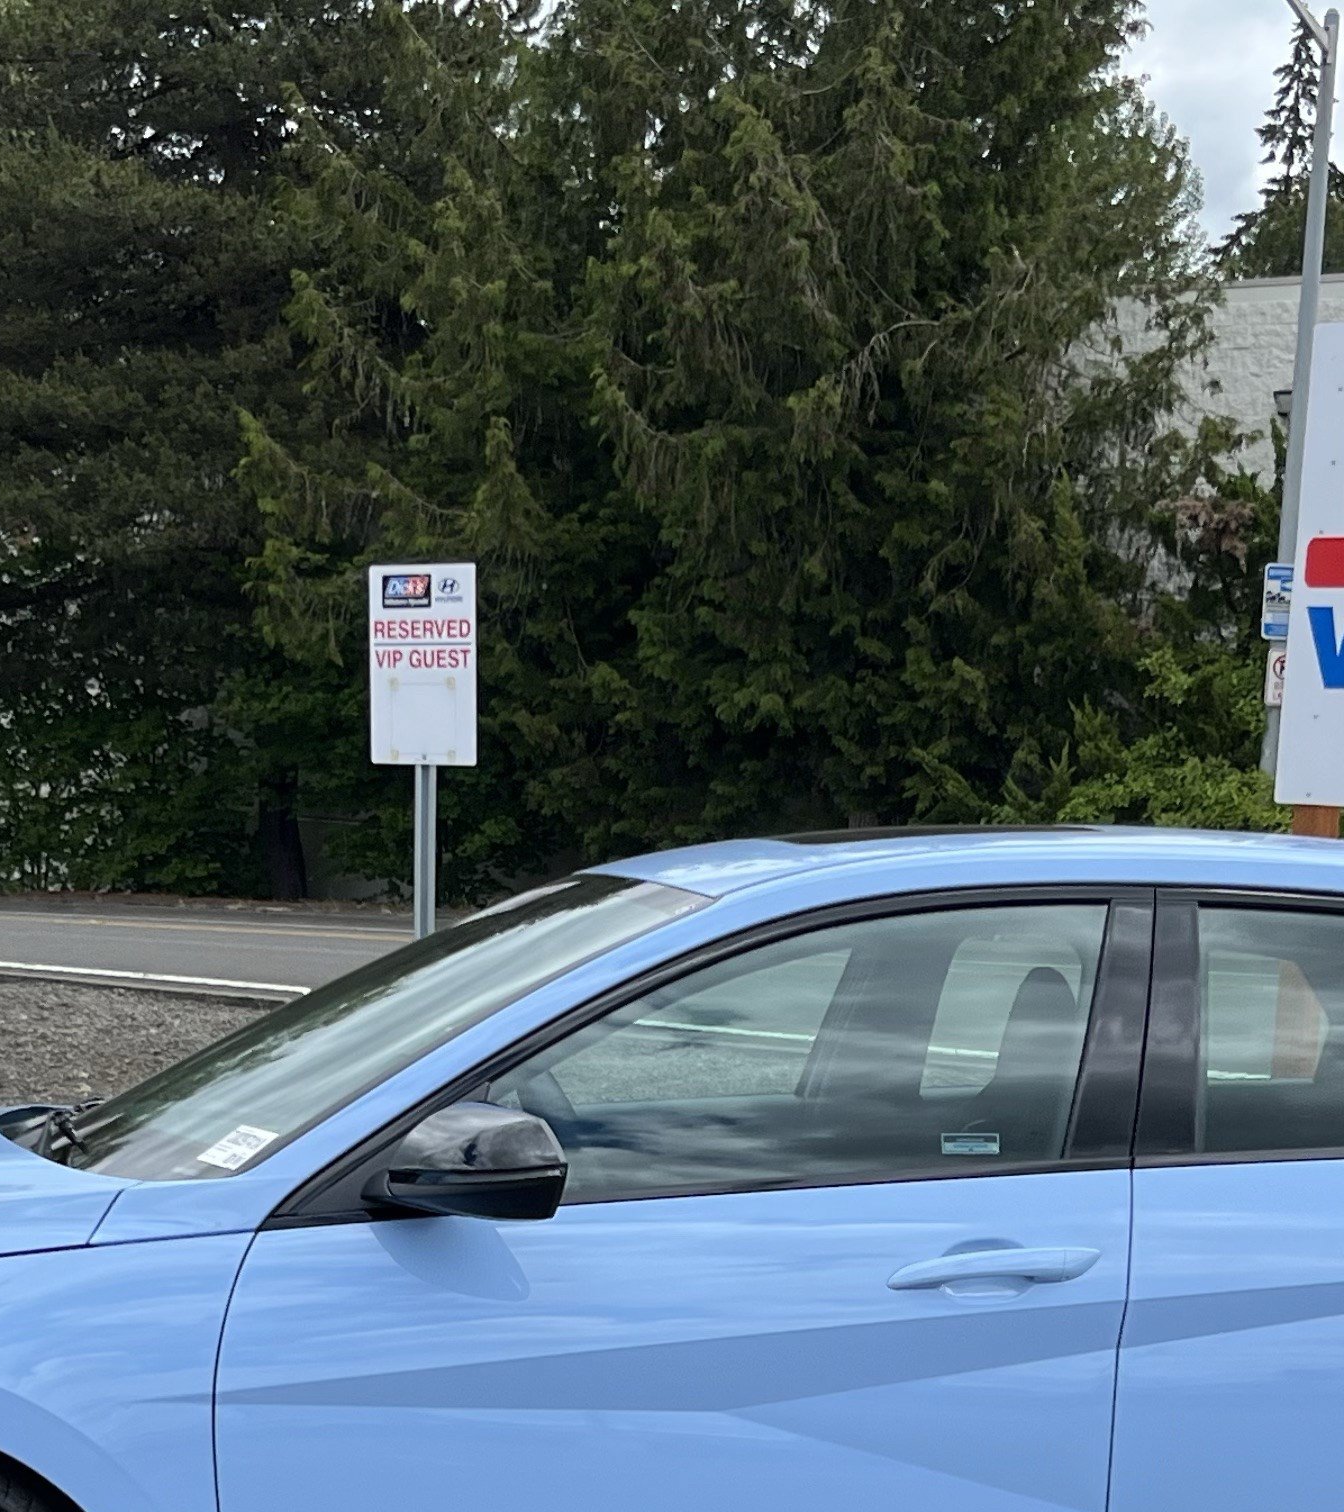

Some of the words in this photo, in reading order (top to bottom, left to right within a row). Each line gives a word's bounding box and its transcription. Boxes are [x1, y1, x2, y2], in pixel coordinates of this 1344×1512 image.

[374, 619, 471, 639] RESERVED
[374, 649, 403, 668] VIP
[409, 649, 471, 669] GUEST
